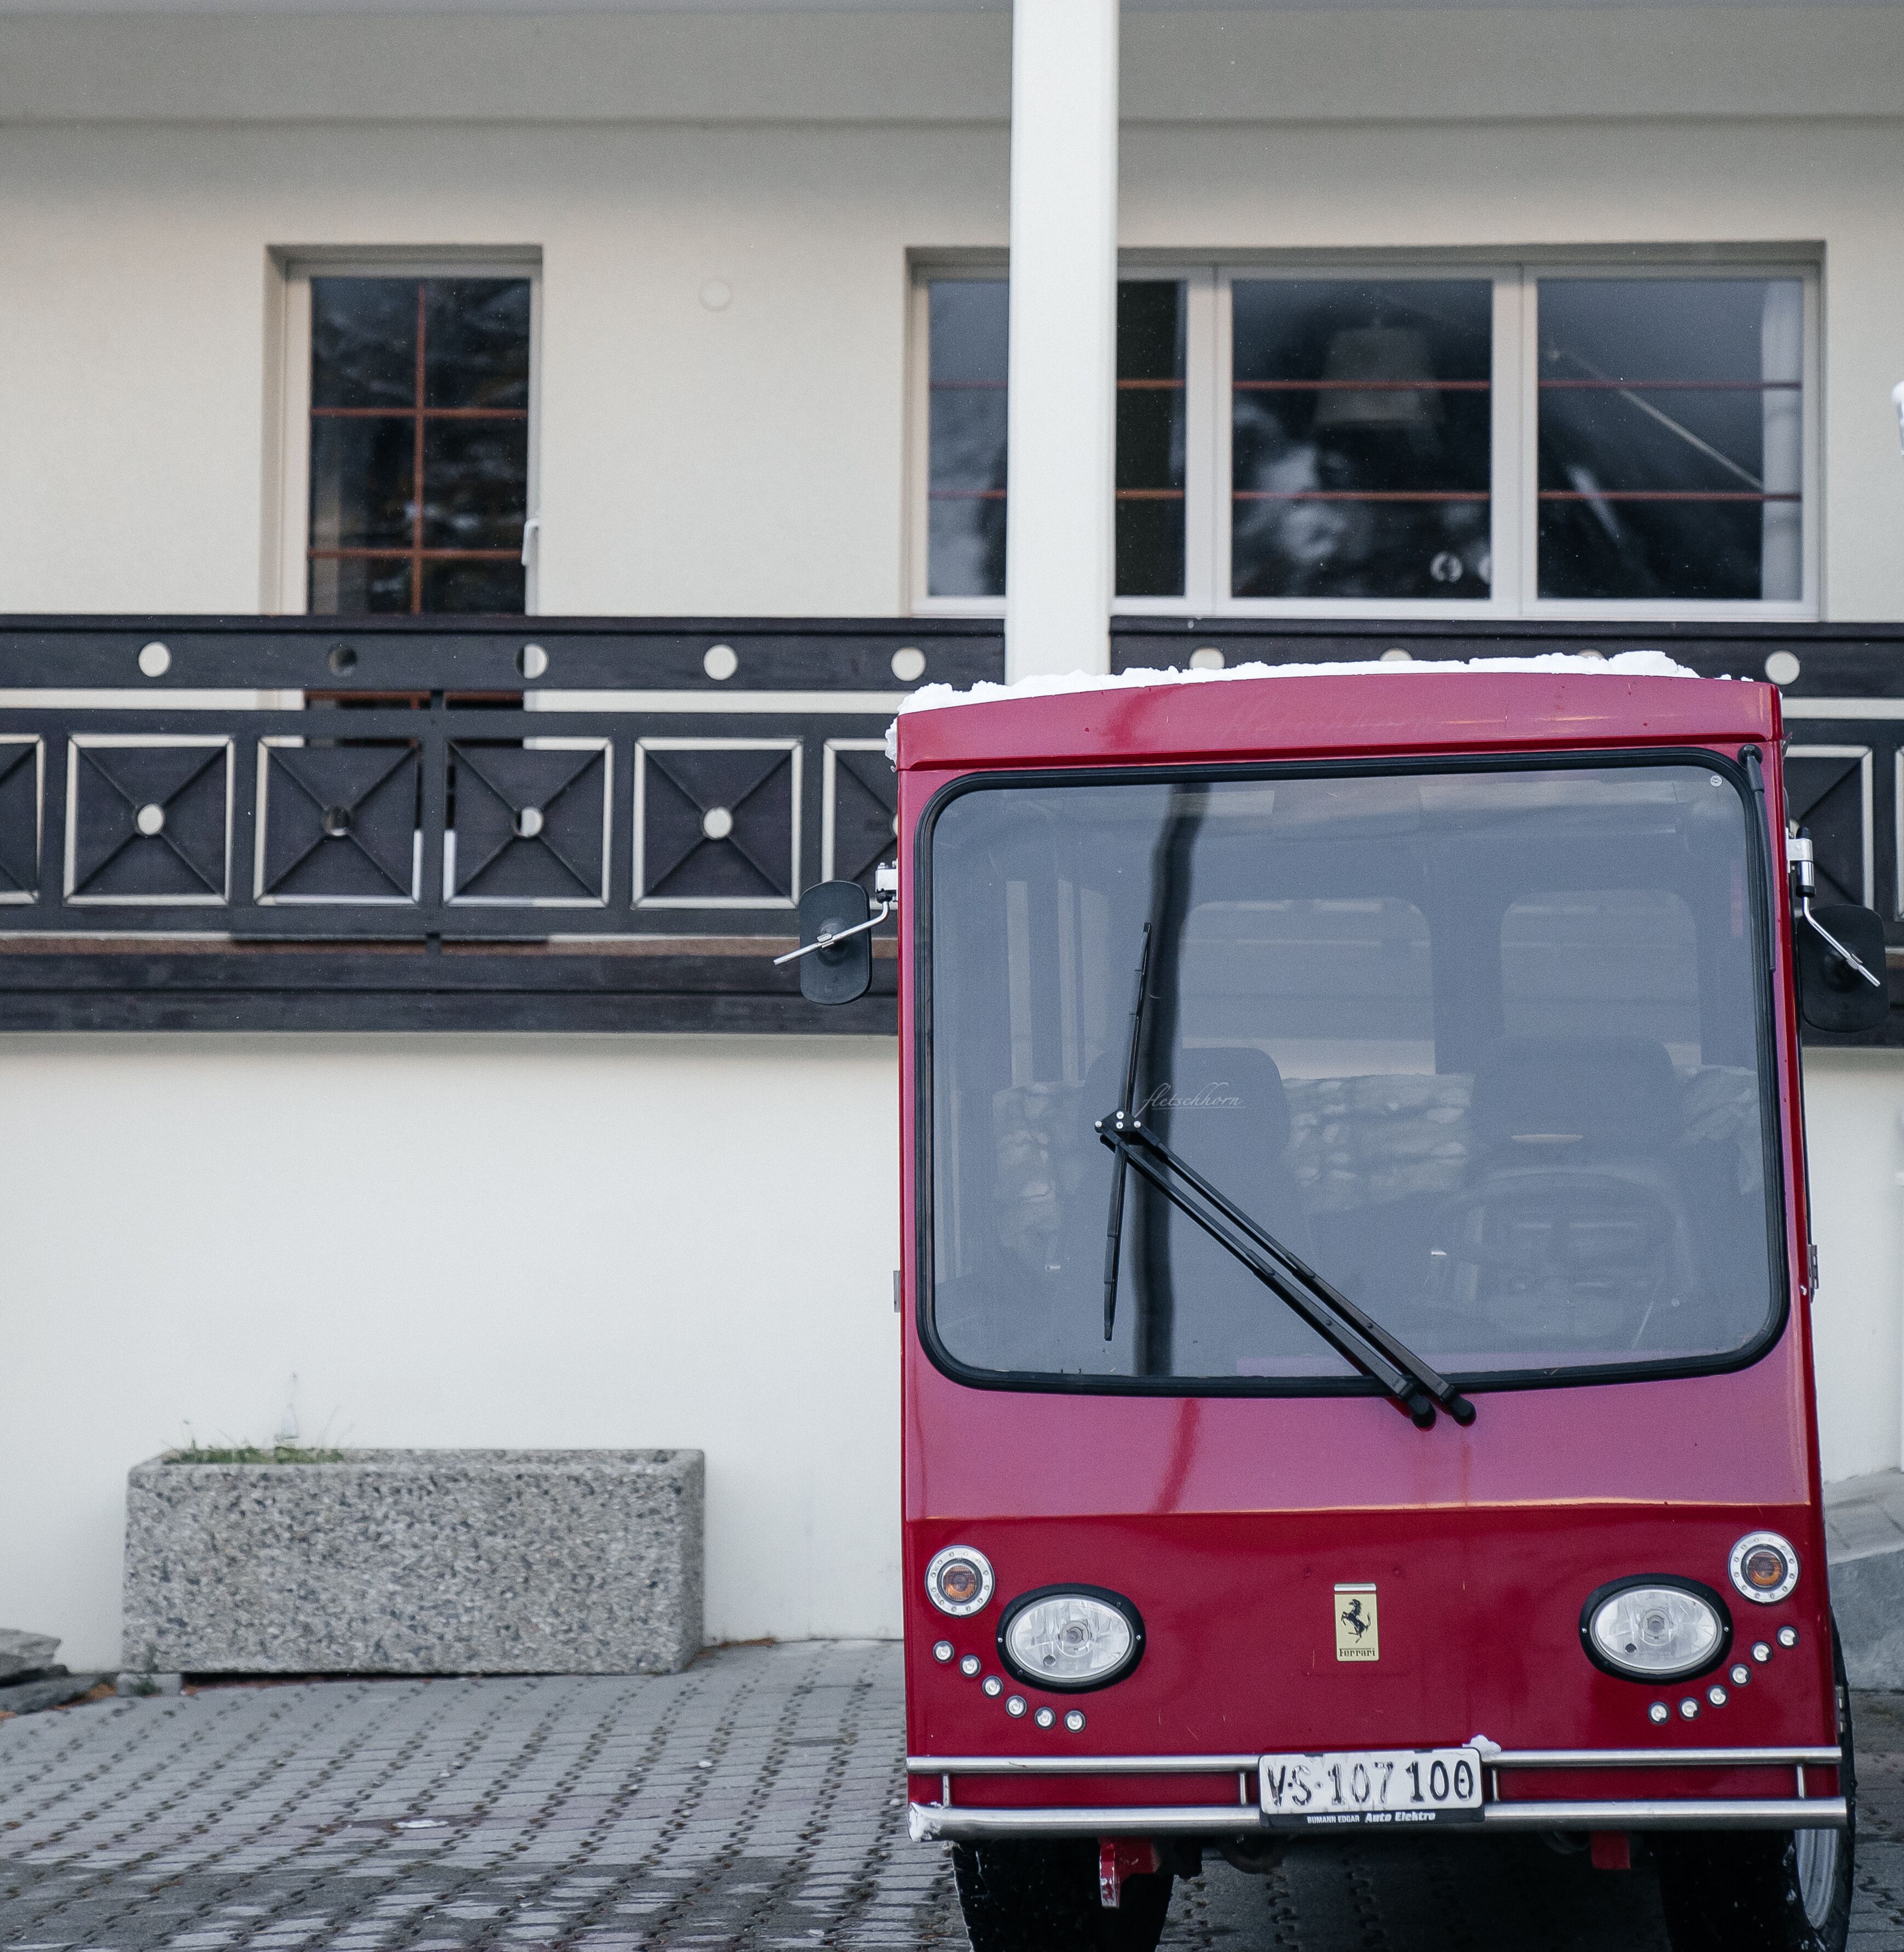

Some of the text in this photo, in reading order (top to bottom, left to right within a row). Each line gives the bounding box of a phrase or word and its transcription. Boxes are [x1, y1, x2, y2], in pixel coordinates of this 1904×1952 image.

[1339, 1648, 1375, 1657] Ferrari
[1365, 1813, 1392, 1823] Auto
[1394, 1811, 1436, 1822] Elektro
